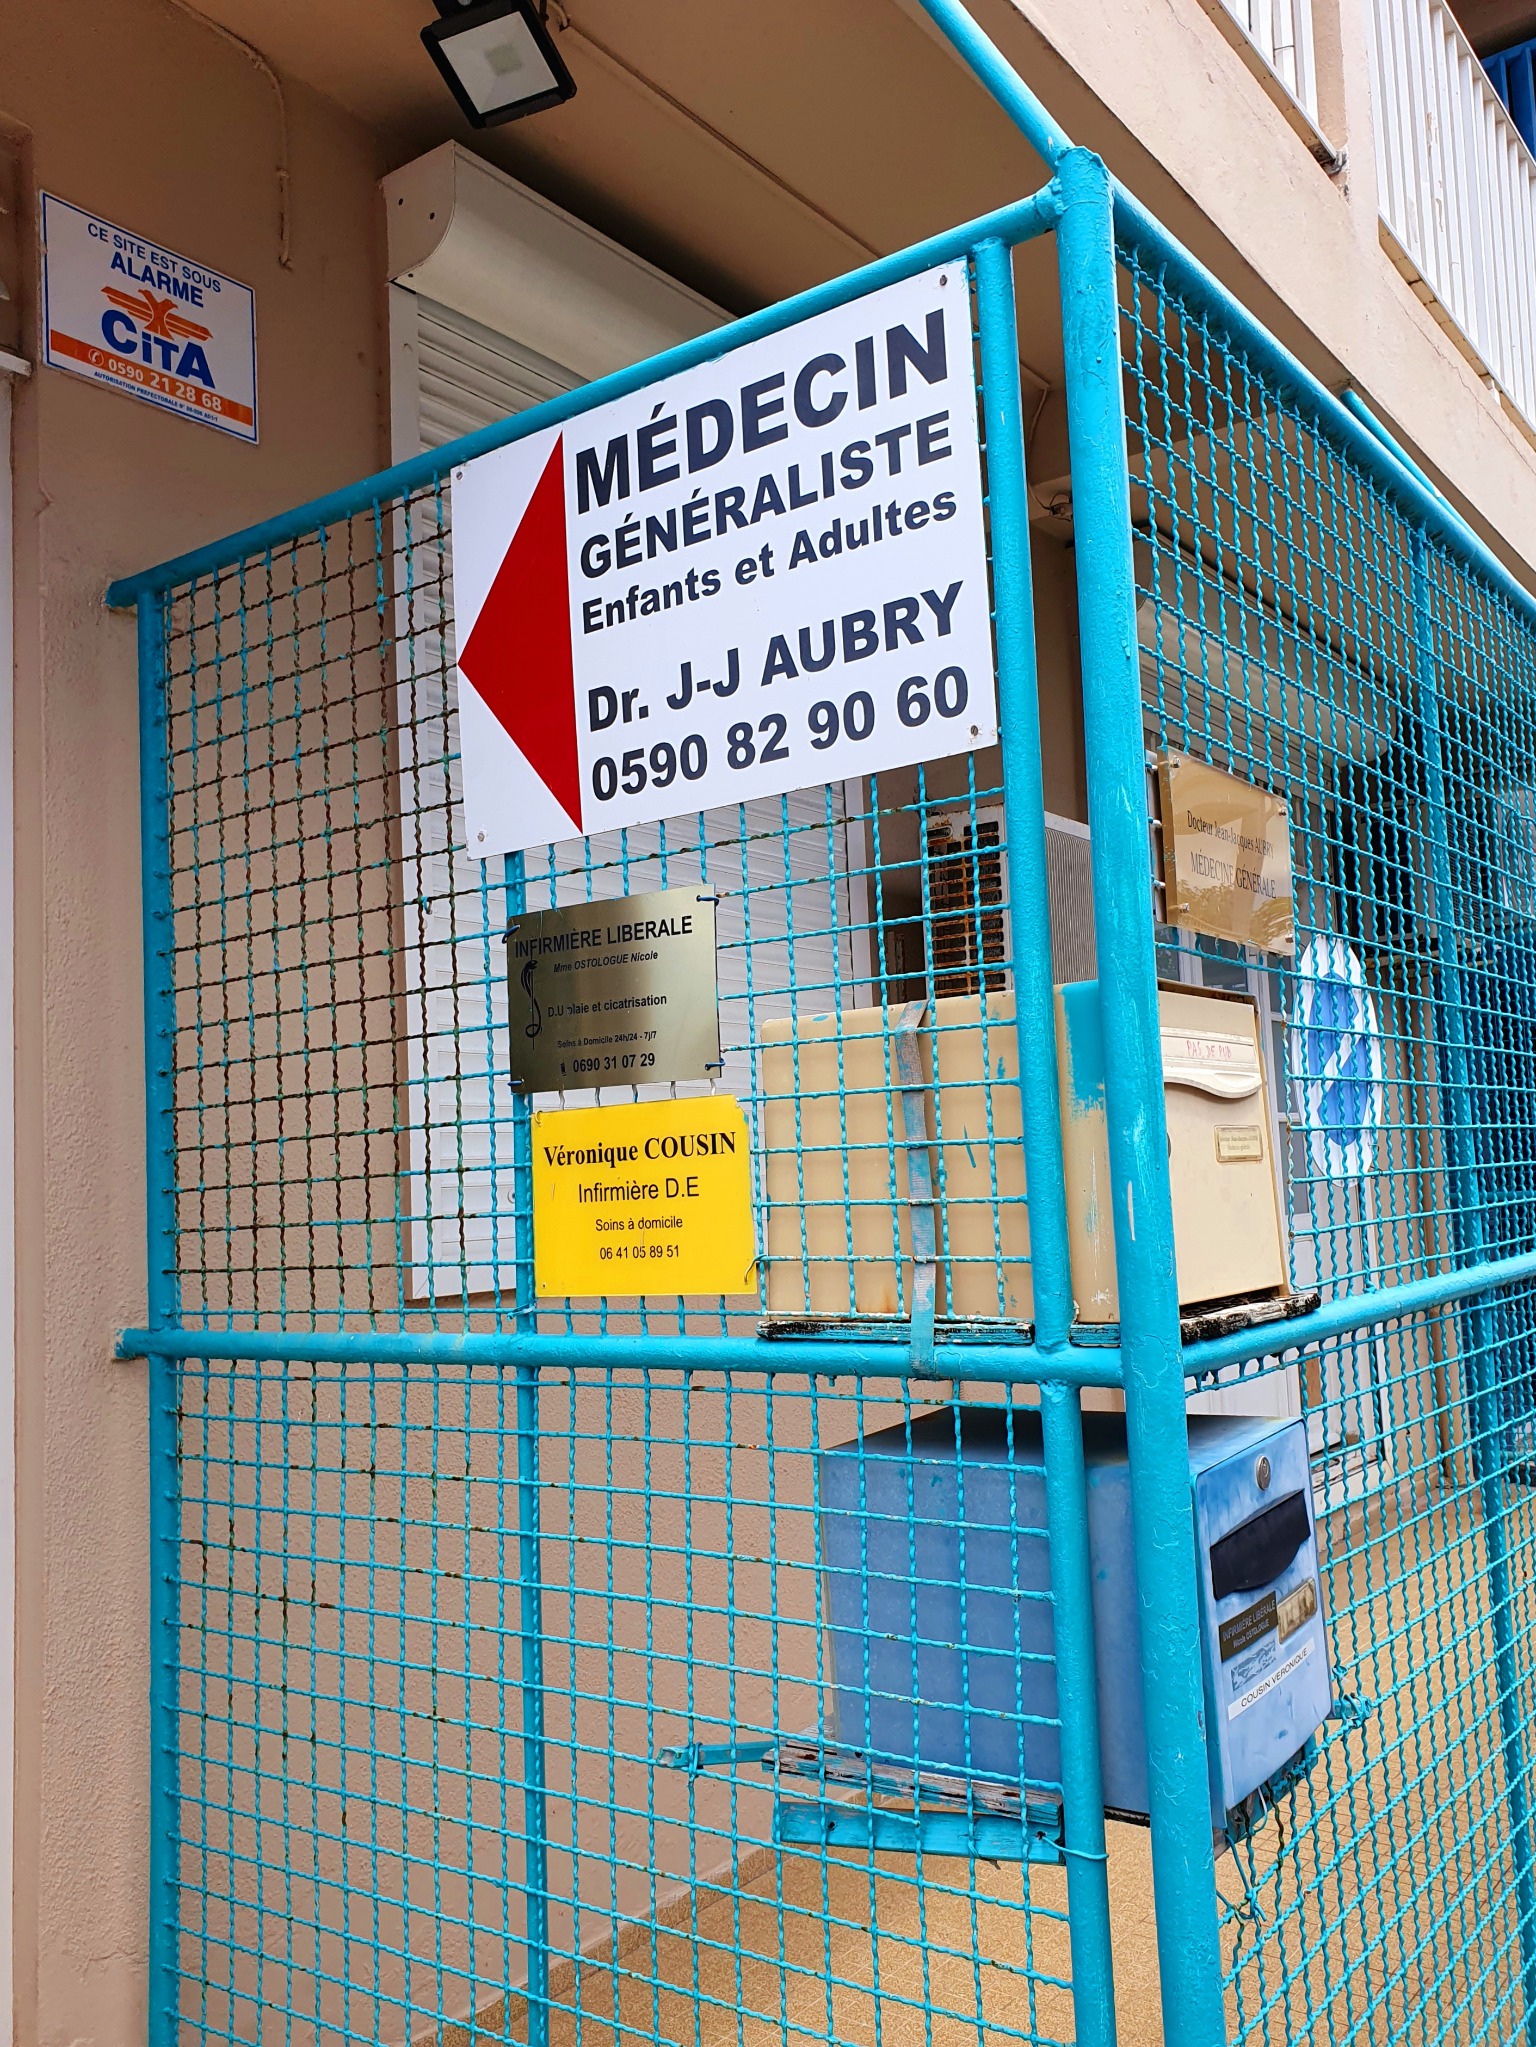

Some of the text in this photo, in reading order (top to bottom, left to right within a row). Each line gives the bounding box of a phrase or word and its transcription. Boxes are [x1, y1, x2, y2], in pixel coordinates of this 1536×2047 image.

[88, 223, 222, 293] CE SITE EST SOUS
[110, 251, 204, 308] ALARME
[94, 371, 136, 391] AUTORISATION
[108, 358, 144, 383] 0590
[150, 371, 170, 393] 21
[176, 381, 196, 402] 28
[201, 392, 222, 412] 68
[575, 308, 948, 515] MÉDECIN
[580, 410, 952, 579] GÉNÉRALISTE
[582, 491, 957, 634] Enfants et Adultes
[588, 580, 963, 732] Dr. J-J AUBRY
[592, 665, 969, 801] 0590 82 90 60
[1187, 810, 1274, 859] Docteur Jean-Jacques AUBRY
[1190, 848, 1277, 899] MÉDECINE GÉNÉRALE
[515, 915, 693, 958] INFIRMIÈRE LIBERALE
[553, 950, 658, 973] Mme OSTOLOGUE Nicole
[548, 1004, 564, 1018] D.U
[592, 1001, 602, 1012] et
[604, 994, 667, 1011] cicatrisation
[557, 1039, 576, 1049] Soins
[577, 1037, 582, 1047] à
[583, 1035, 613, 1046] Domicile
[615, 1032, 638, 1043] 24h/24
[644, 1030, 657, 1041] 7j/7
[1186, 1040, 1202, 1057] PAS
[1206, 1045, 1215, 1058] DE
[573, 1053, 655, 1072] 0690 31 07 29
[543, 1131, 736, 1168] Véronique COUSIN
[578, 1176, 700, 1203] Infirmière D.E
[595, 1215, 683, 1232] Soins à domicile
[600, 1245, 679, 1260] 06 41 05 89 51
[1222, 1615, 1253, 1641] INFIRMIÈRE
[1240, 1647, 1308, 1707] COUSIN VERONIQUE
